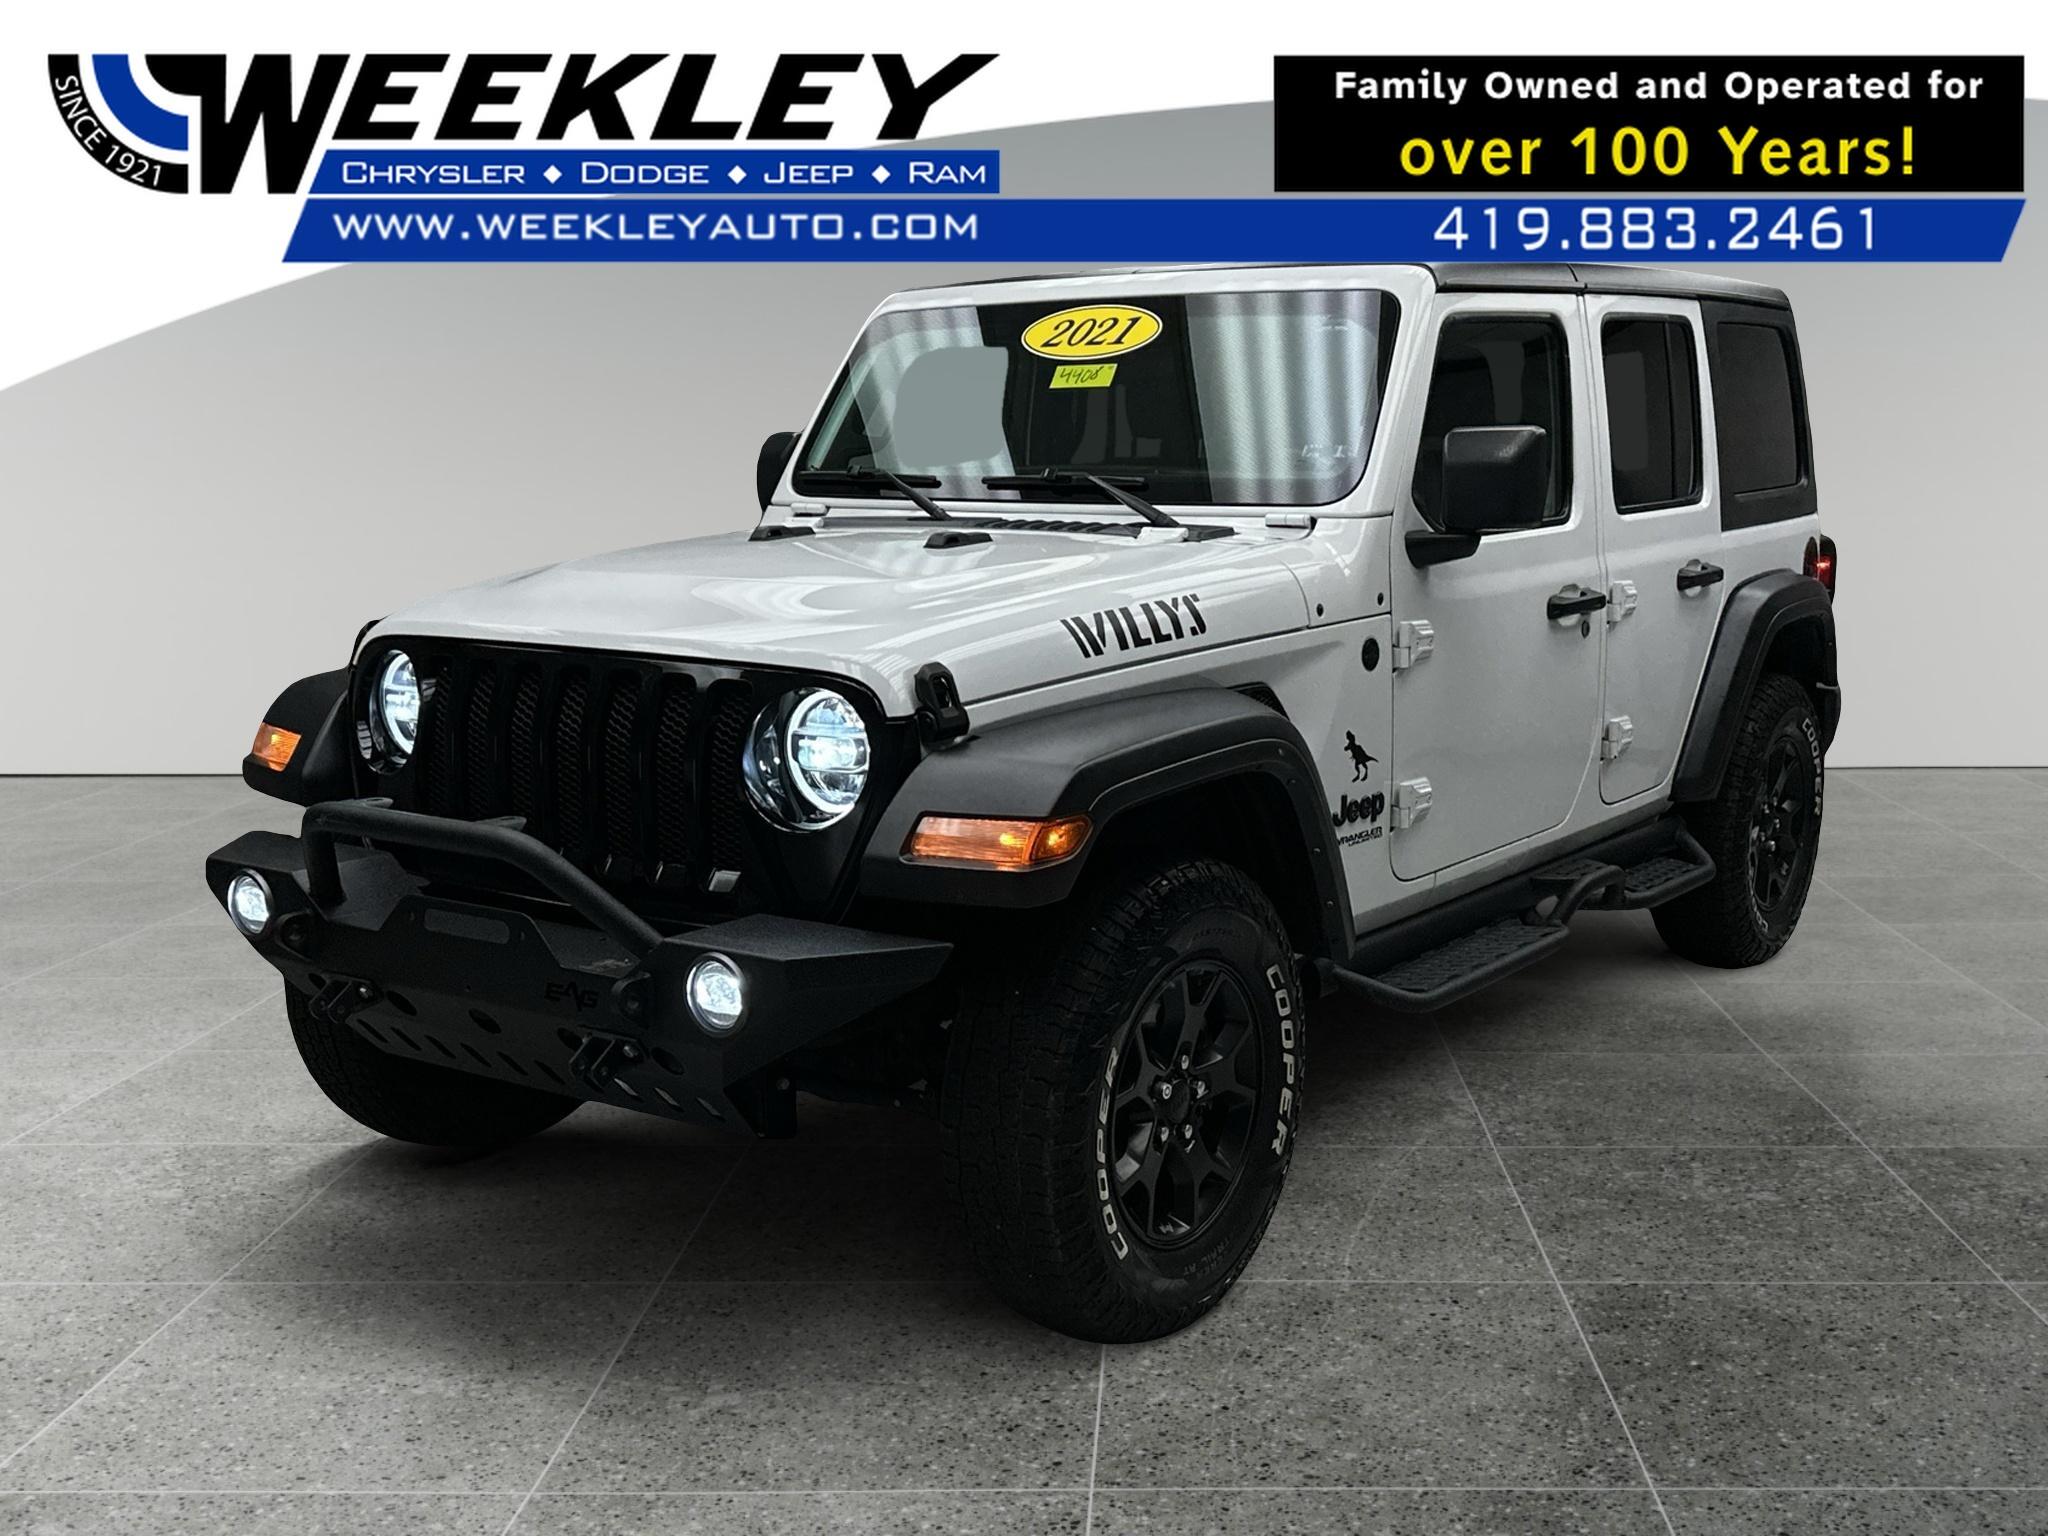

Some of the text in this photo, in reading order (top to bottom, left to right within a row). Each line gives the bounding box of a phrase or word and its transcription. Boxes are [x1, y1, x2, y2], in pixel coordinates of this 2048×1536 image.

[1040, 316, 1142, 348] 2021
[1060, 594, 1207, 659] WILLYS
[1801, 717, 1822, 816] COOPER
[1332, 791, 1385, 827] Jeep
[1265, 963, 1297, 1157] COOPER
[1096, 1047, 1128, 1261] COOPER
